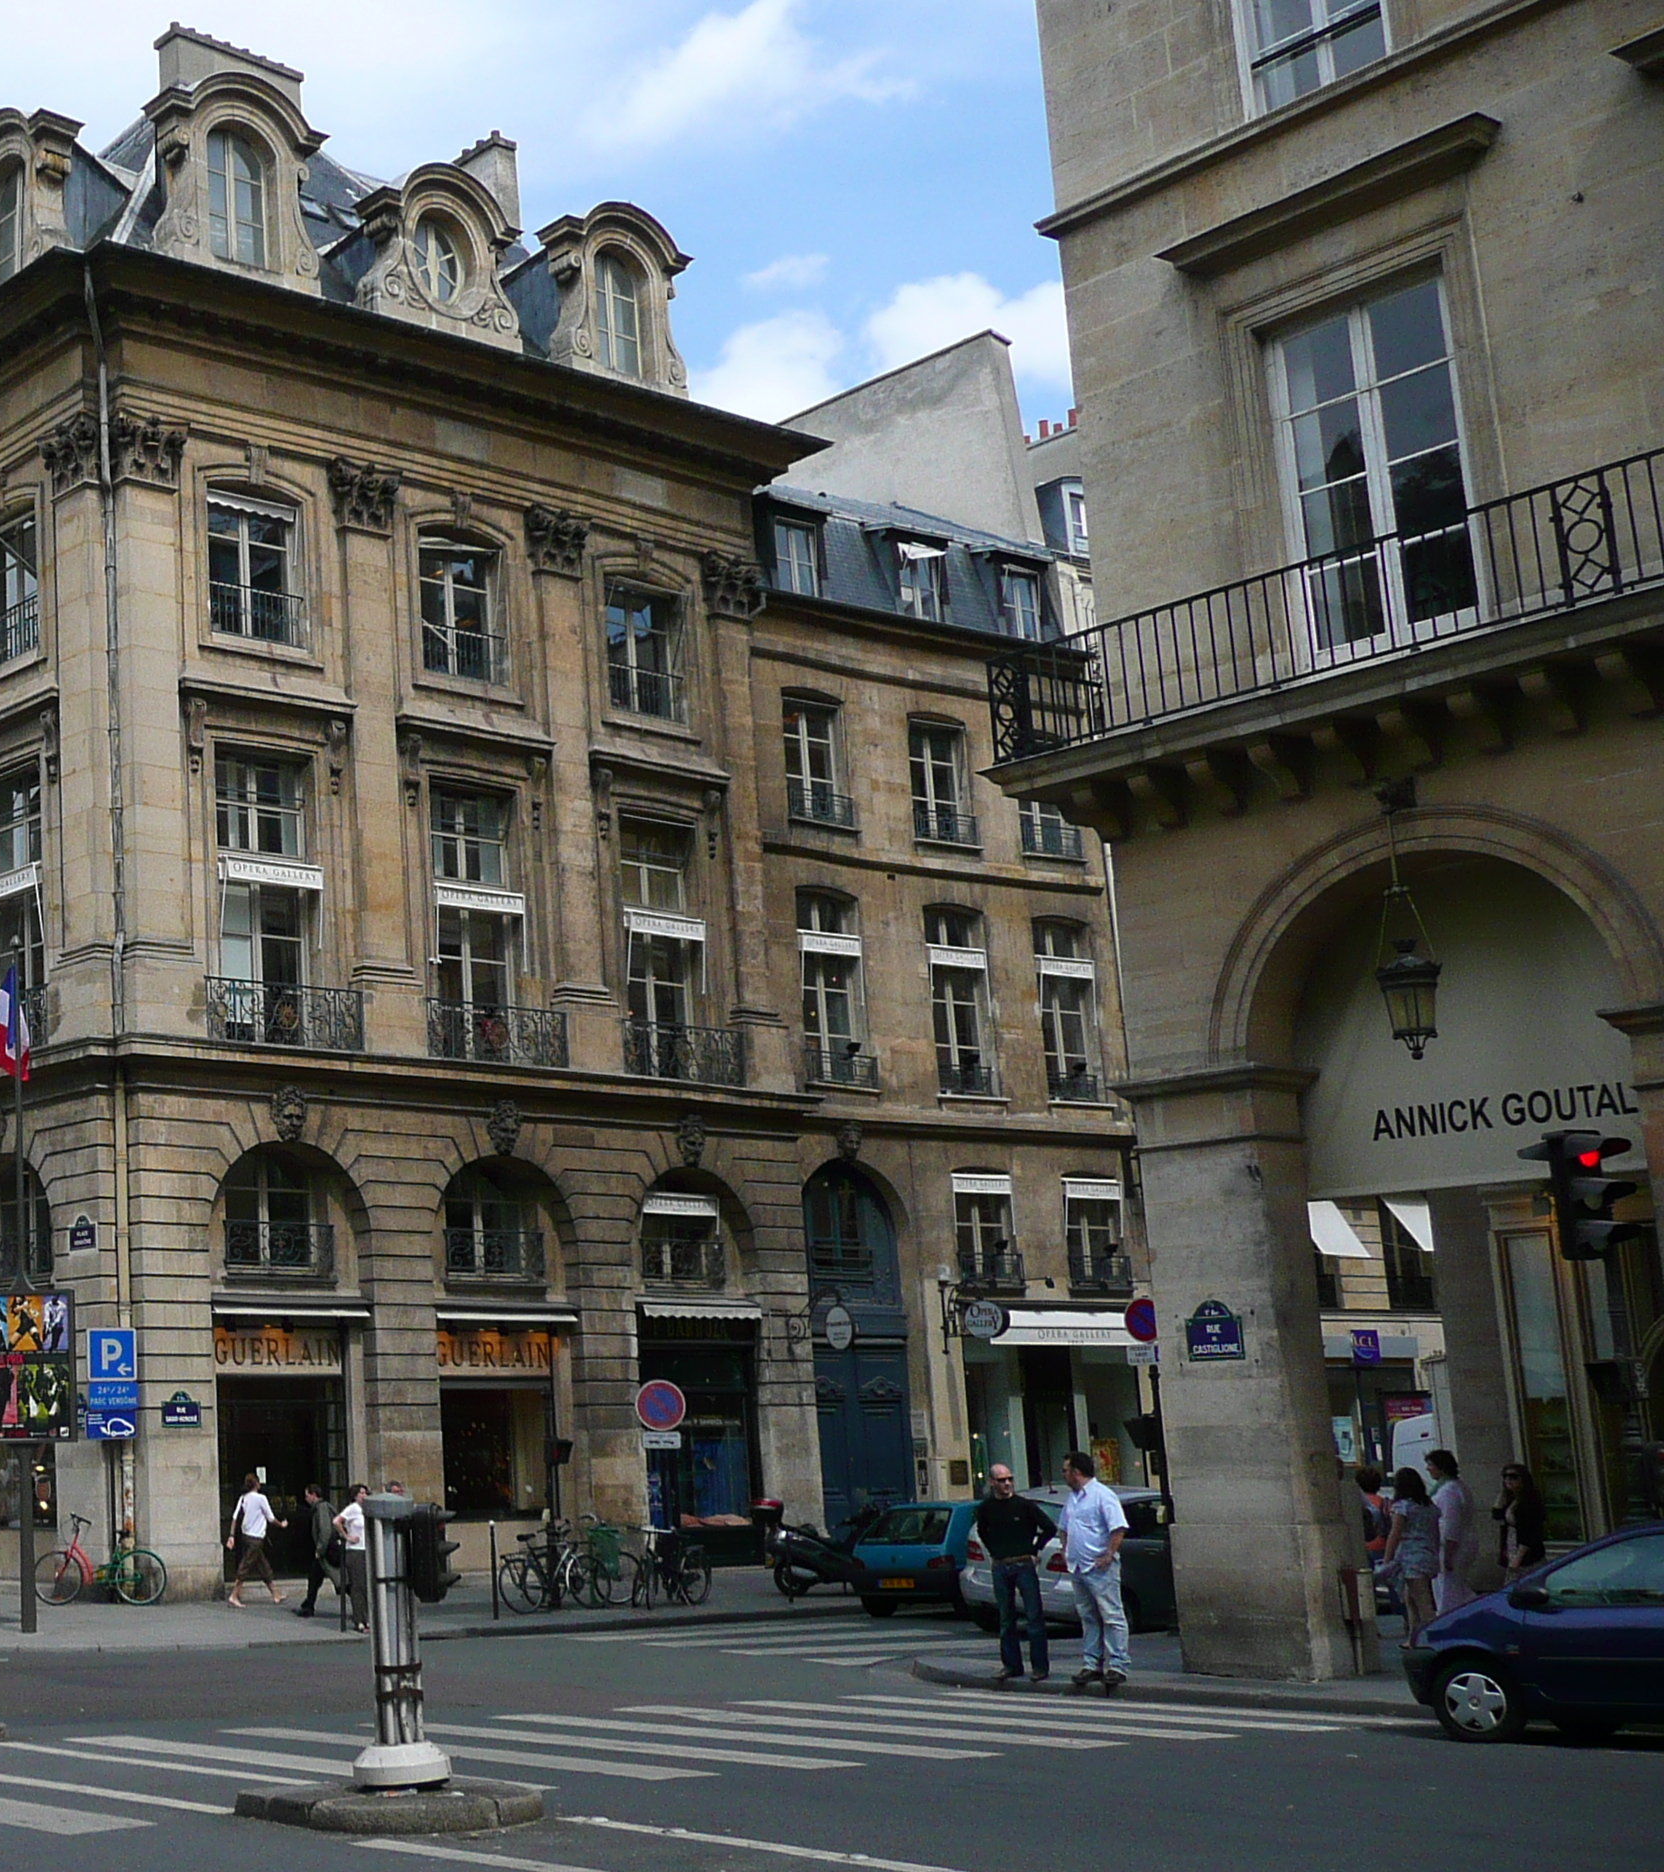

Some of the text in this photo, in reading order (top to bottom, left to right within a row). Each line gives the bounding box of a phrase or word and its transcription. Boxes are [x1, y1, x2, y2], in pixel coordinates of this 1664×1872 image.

[232, 862, 317, 881] OPERA GALLERY
[1372, 1081, 1639, 1142] ANNICK GOUTAL
[970, 1304, 999, 1318] OPERA
[966, 1315, 999, 1330] GALLERY
[1205, 1323, 1222, 1334] RUE
[1037, 1328, 1112, 1340] OPERA GALLERY
[100, 1337, 123, 1371] P
[214, 1337, 340, 1367] GUERLAIN
[437, 1340, 549, 1368] GUERLAIN
[1192, 1343, 1242, 1355] CASTIGLIONE
